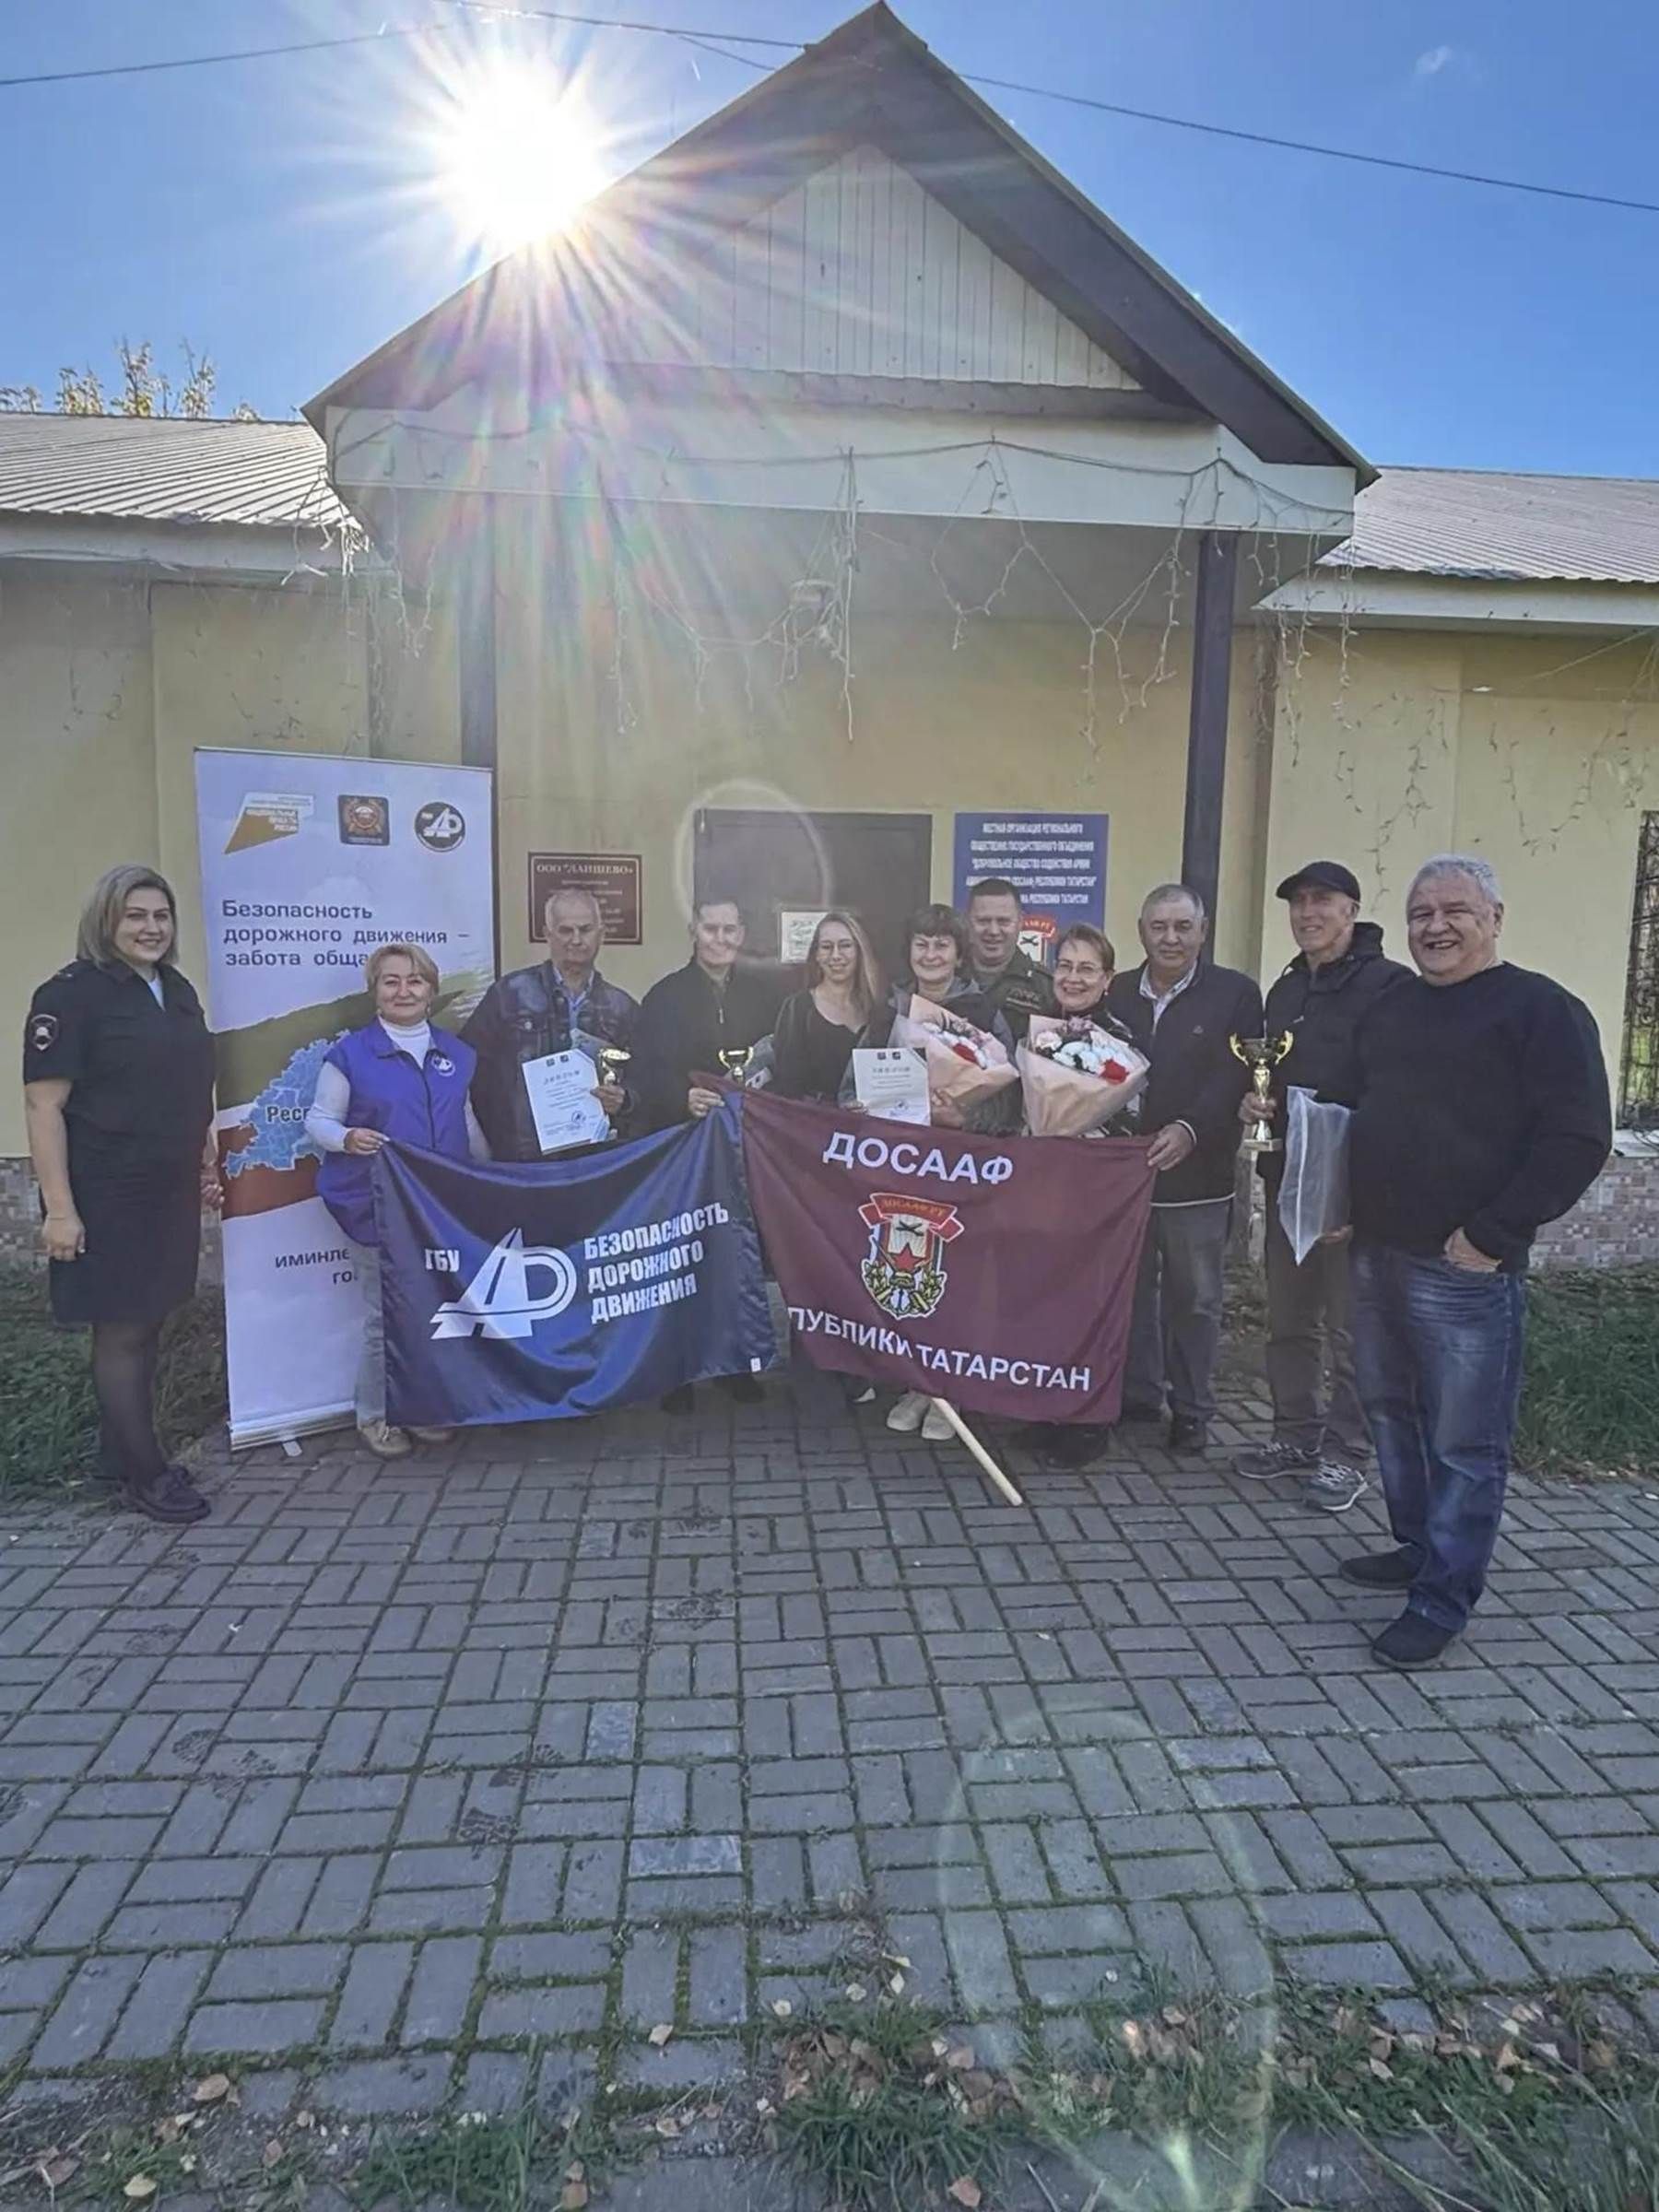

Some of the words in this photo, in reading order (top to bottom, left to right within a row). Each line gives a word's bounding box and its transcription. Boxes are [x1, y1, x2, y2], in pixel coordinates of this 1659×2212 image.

[536, 864, 562, 874] ООО
[222, 900, 372, 920] Безопасность
[223, 927, 342, 946] дорожного
[353, 929, 447, 946] движения
[226, 949, 300, 967] забота
[822, 1132, 1014, 1184] ДОСААФ
[583, 1202, 729, 1261] БЕЗОПАСНОСТЬ
[424, 1249, 460, 1273] ГБУ
[587, 1240, 704, 1294] ДОРОЖНОГО
[333, 1270, 359, 1285] го
[591, 1273, 697, 1324] ДВИЖЕНИЯ
[915, 1344, 1090, 1392] ТАТАРСТАН
